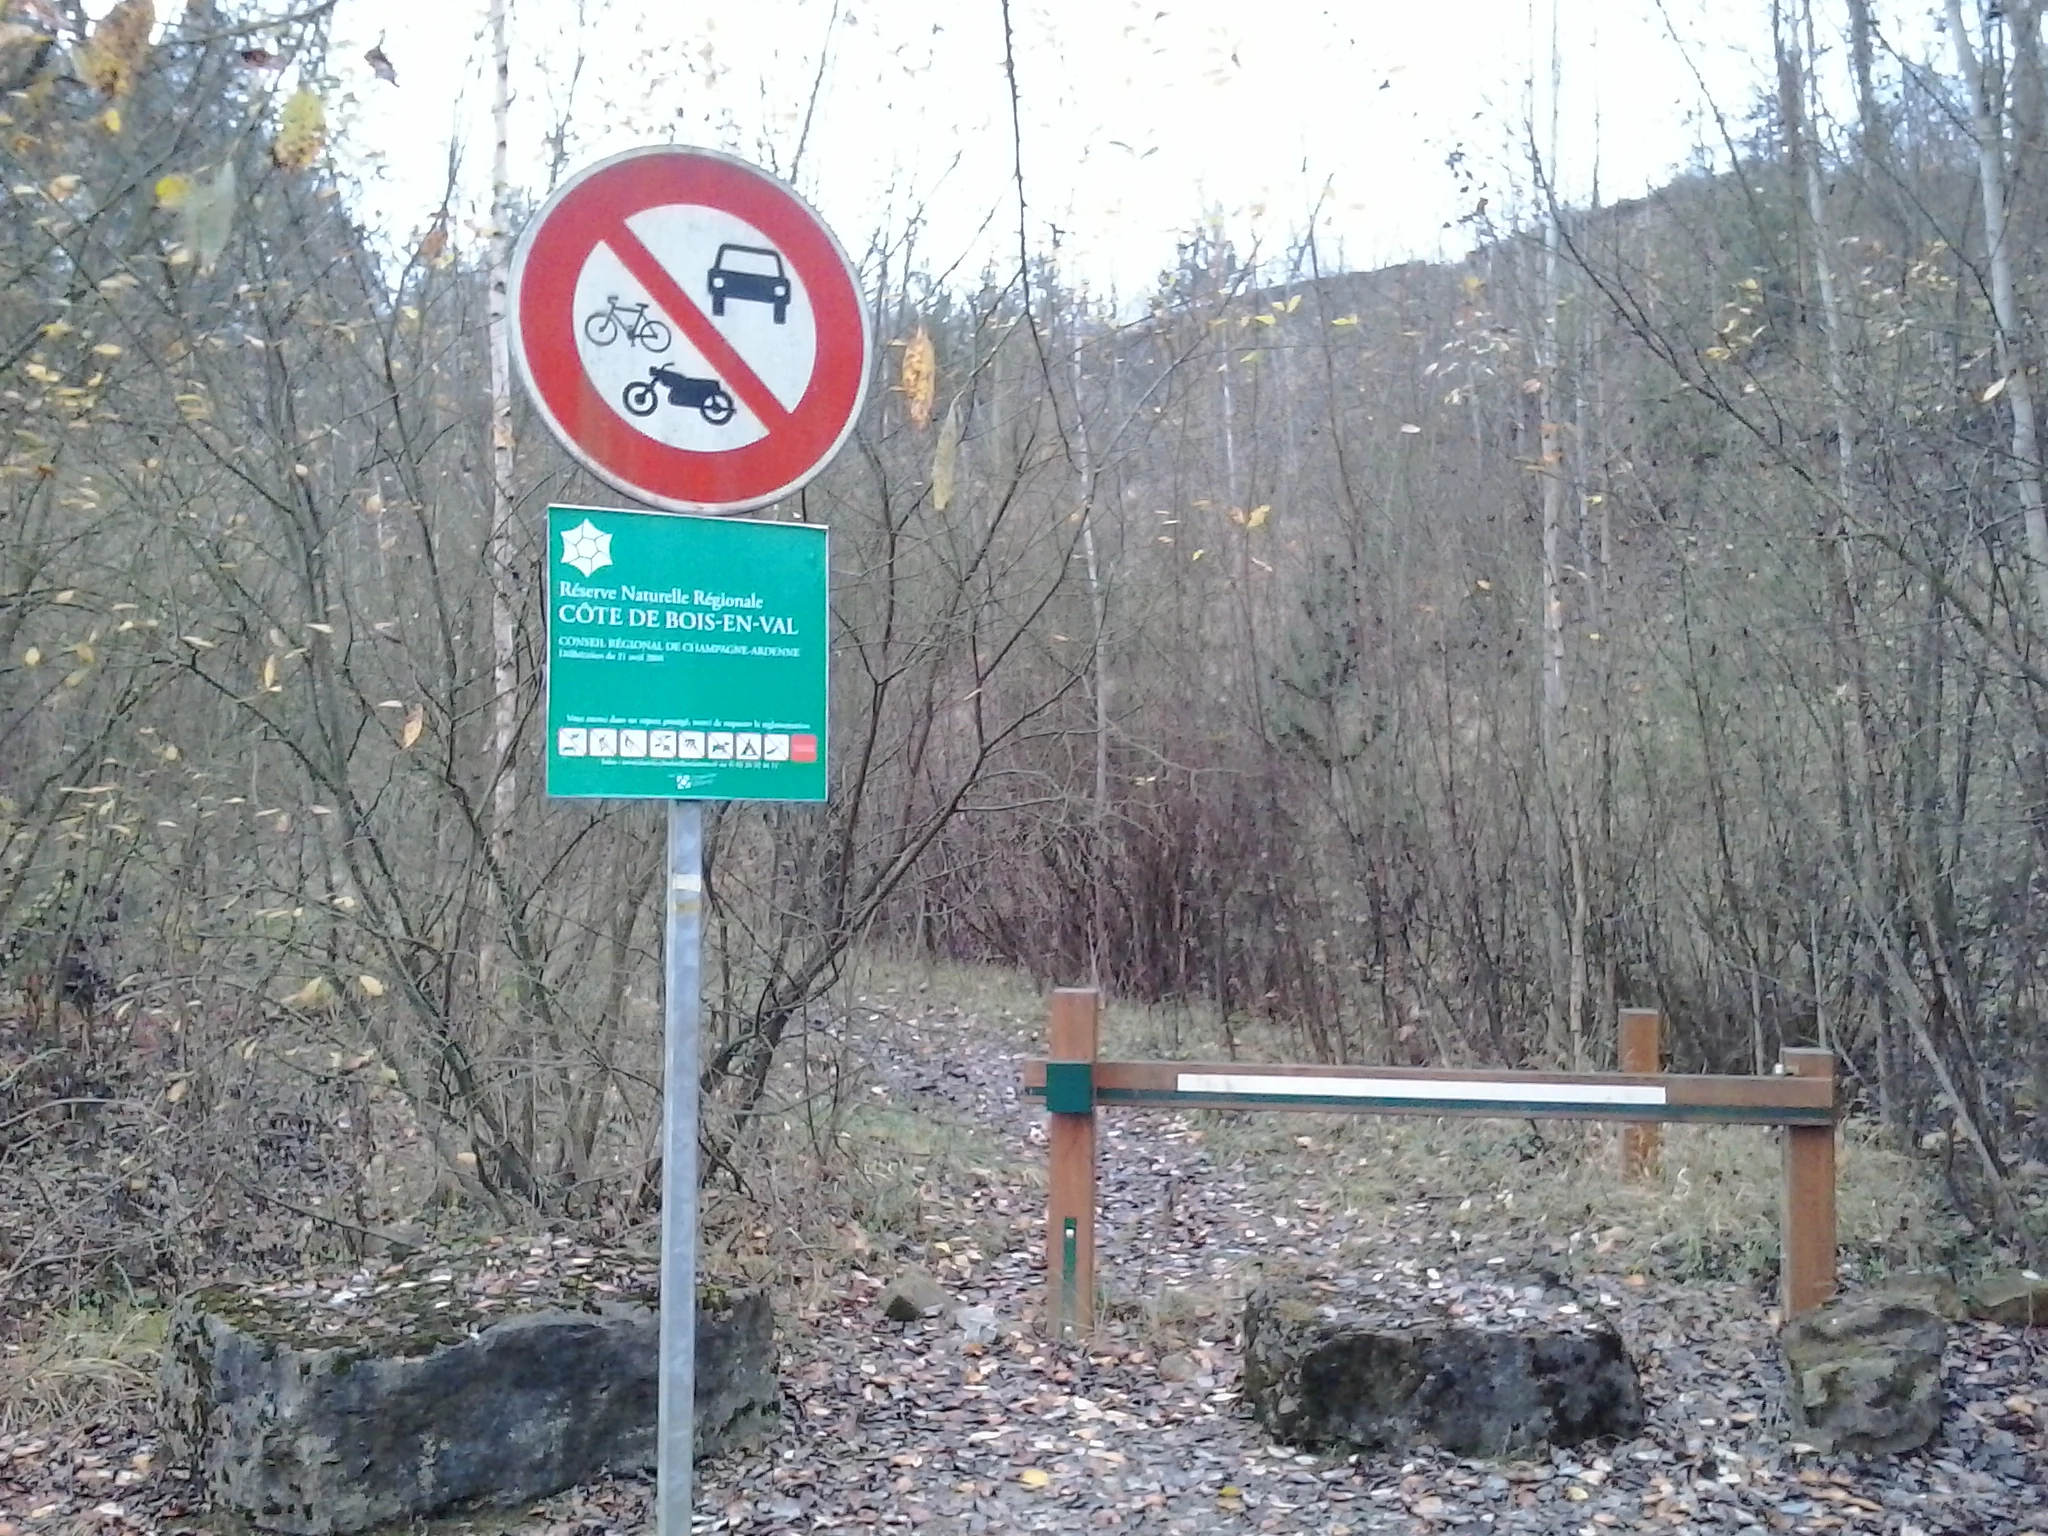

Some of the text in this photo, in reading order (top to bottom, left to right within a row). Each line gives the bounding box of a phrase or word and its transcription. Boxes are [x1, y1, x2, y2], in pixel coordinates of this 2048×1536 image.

[559, 581, 763, 612] Réserve Naturelle Régionale
[558, 602, 799, 635] CÔTE DE BOIS-EN-VAL
[558, 635, 607, 648] CONSEIL
[607, 636, 664, 651] RÉGIONAL
[665, 641, 680, 652] DE
[681, 642, 801, 657] CHAMPAGNE-ARDENNE
